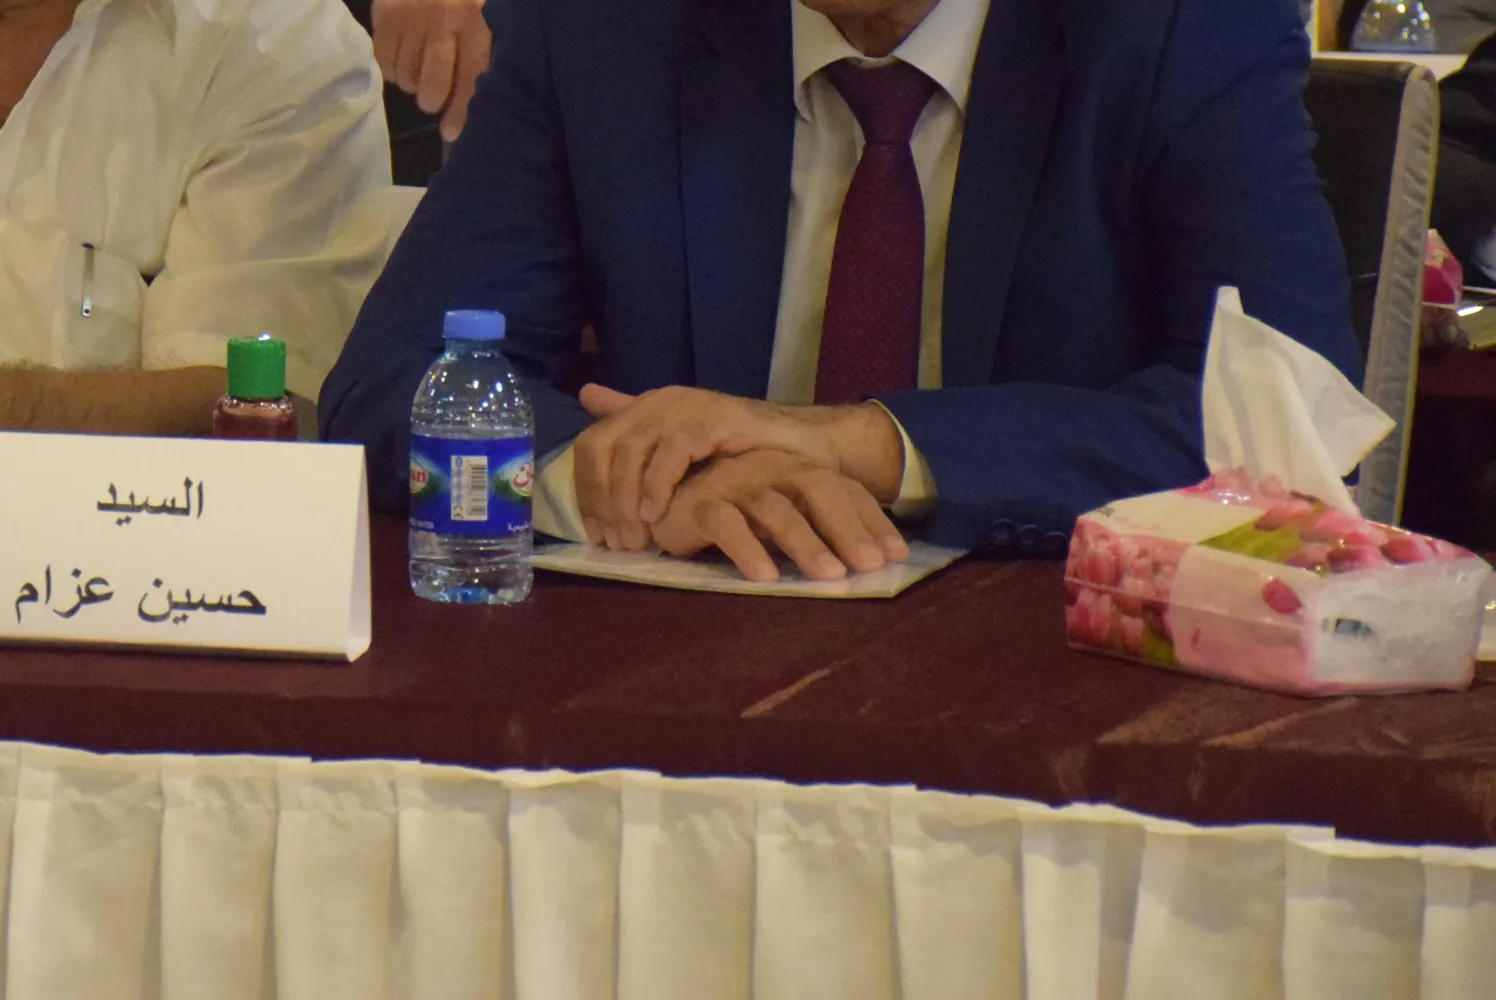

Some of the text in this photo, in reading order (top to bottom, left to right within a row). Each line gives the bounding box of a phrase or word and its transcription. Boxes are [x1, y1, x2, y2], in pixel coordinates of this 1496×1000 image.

[97, 476, 204, 526] السيد
[15, 564, 267, 625] حسين عزام
